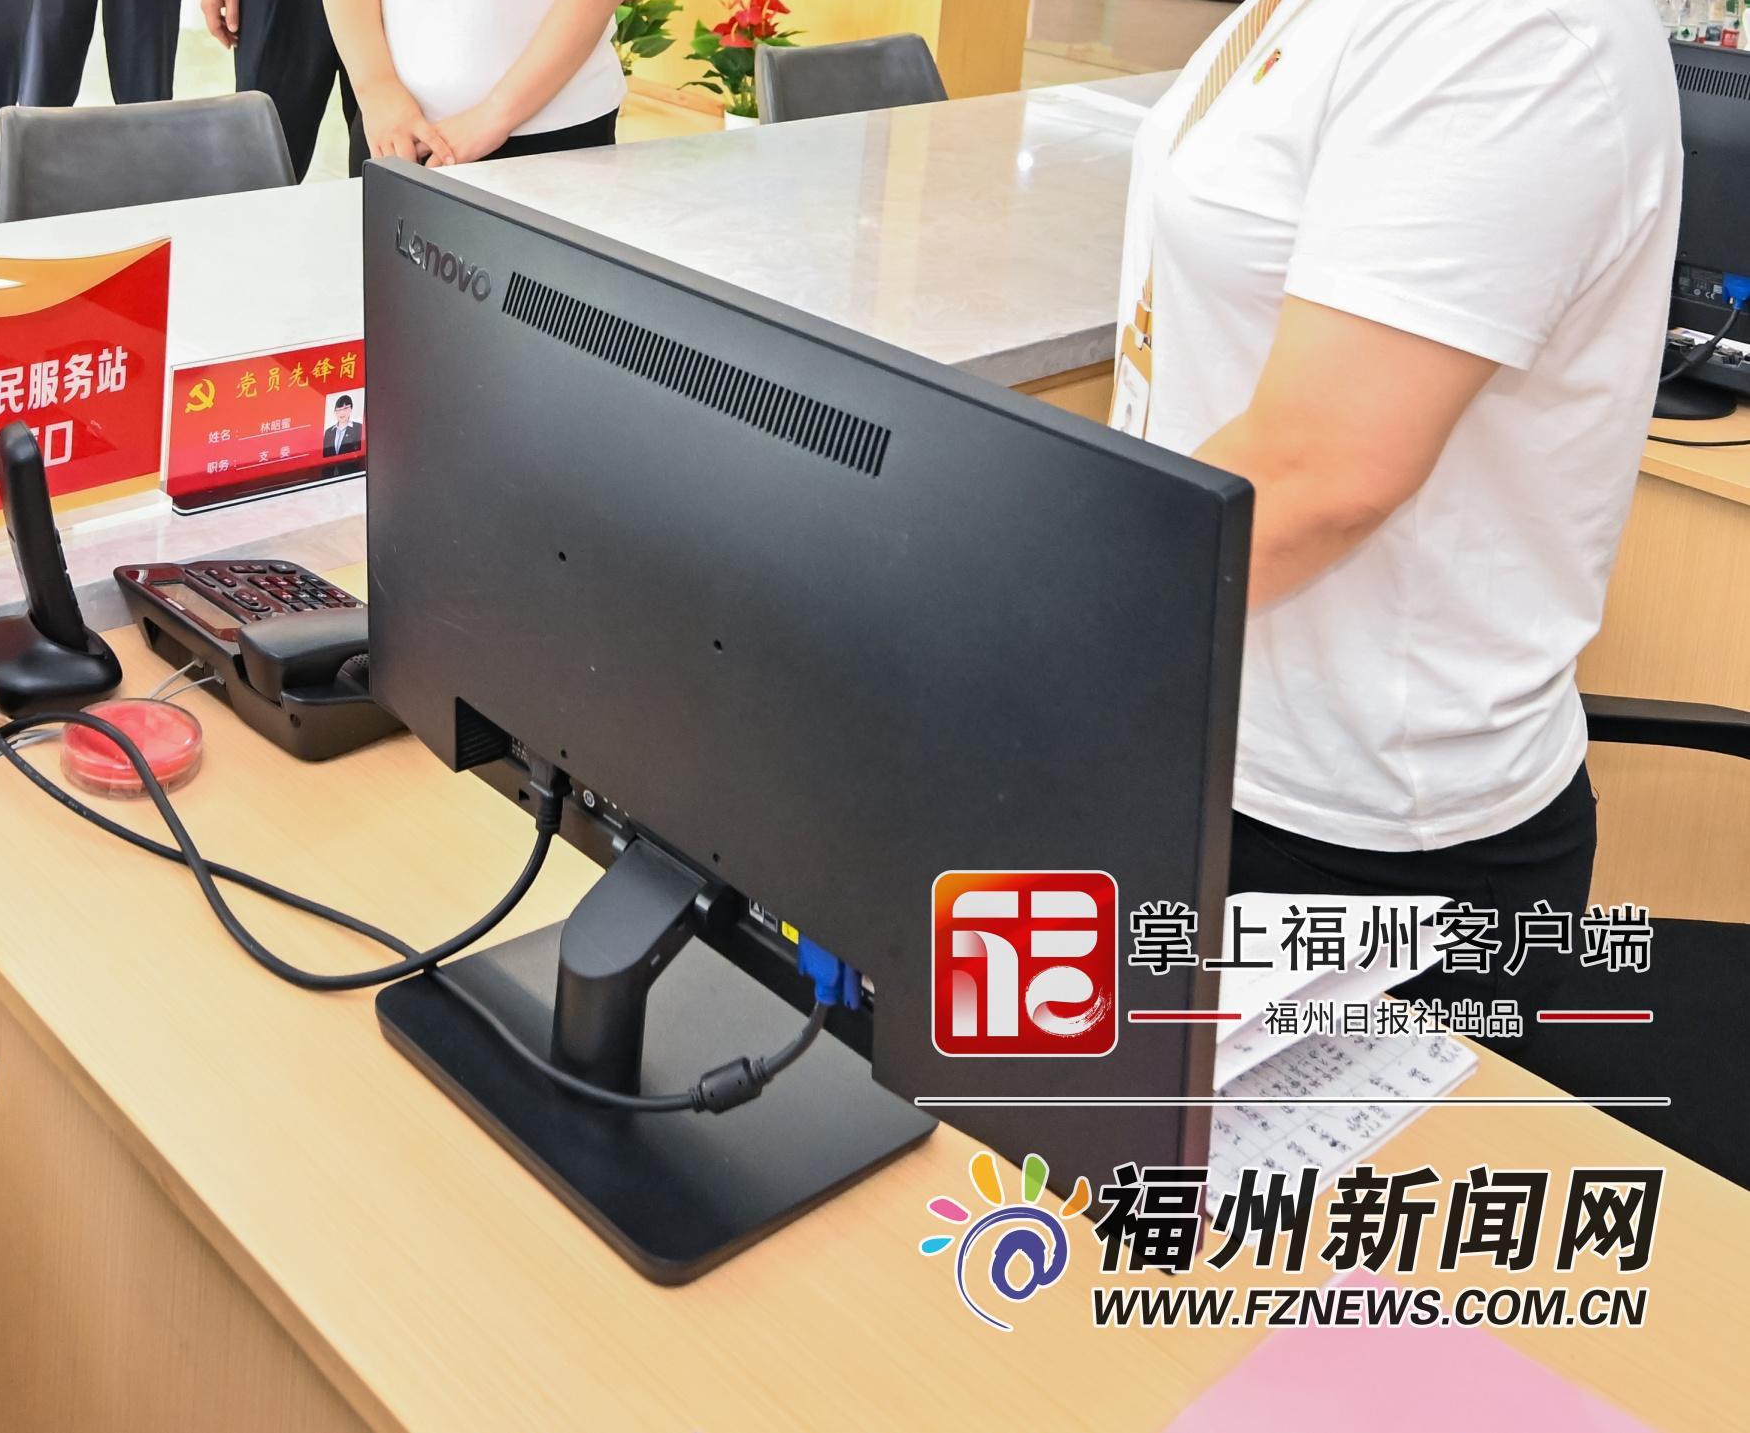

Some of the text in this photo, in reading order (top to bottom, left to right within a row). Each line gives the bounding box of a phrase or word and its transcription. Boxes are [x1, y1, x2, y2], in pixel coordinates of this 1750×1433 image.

[395, 216, 492, 302] Lenovo
[235, 352, 358, 399] 党员先锋岗
